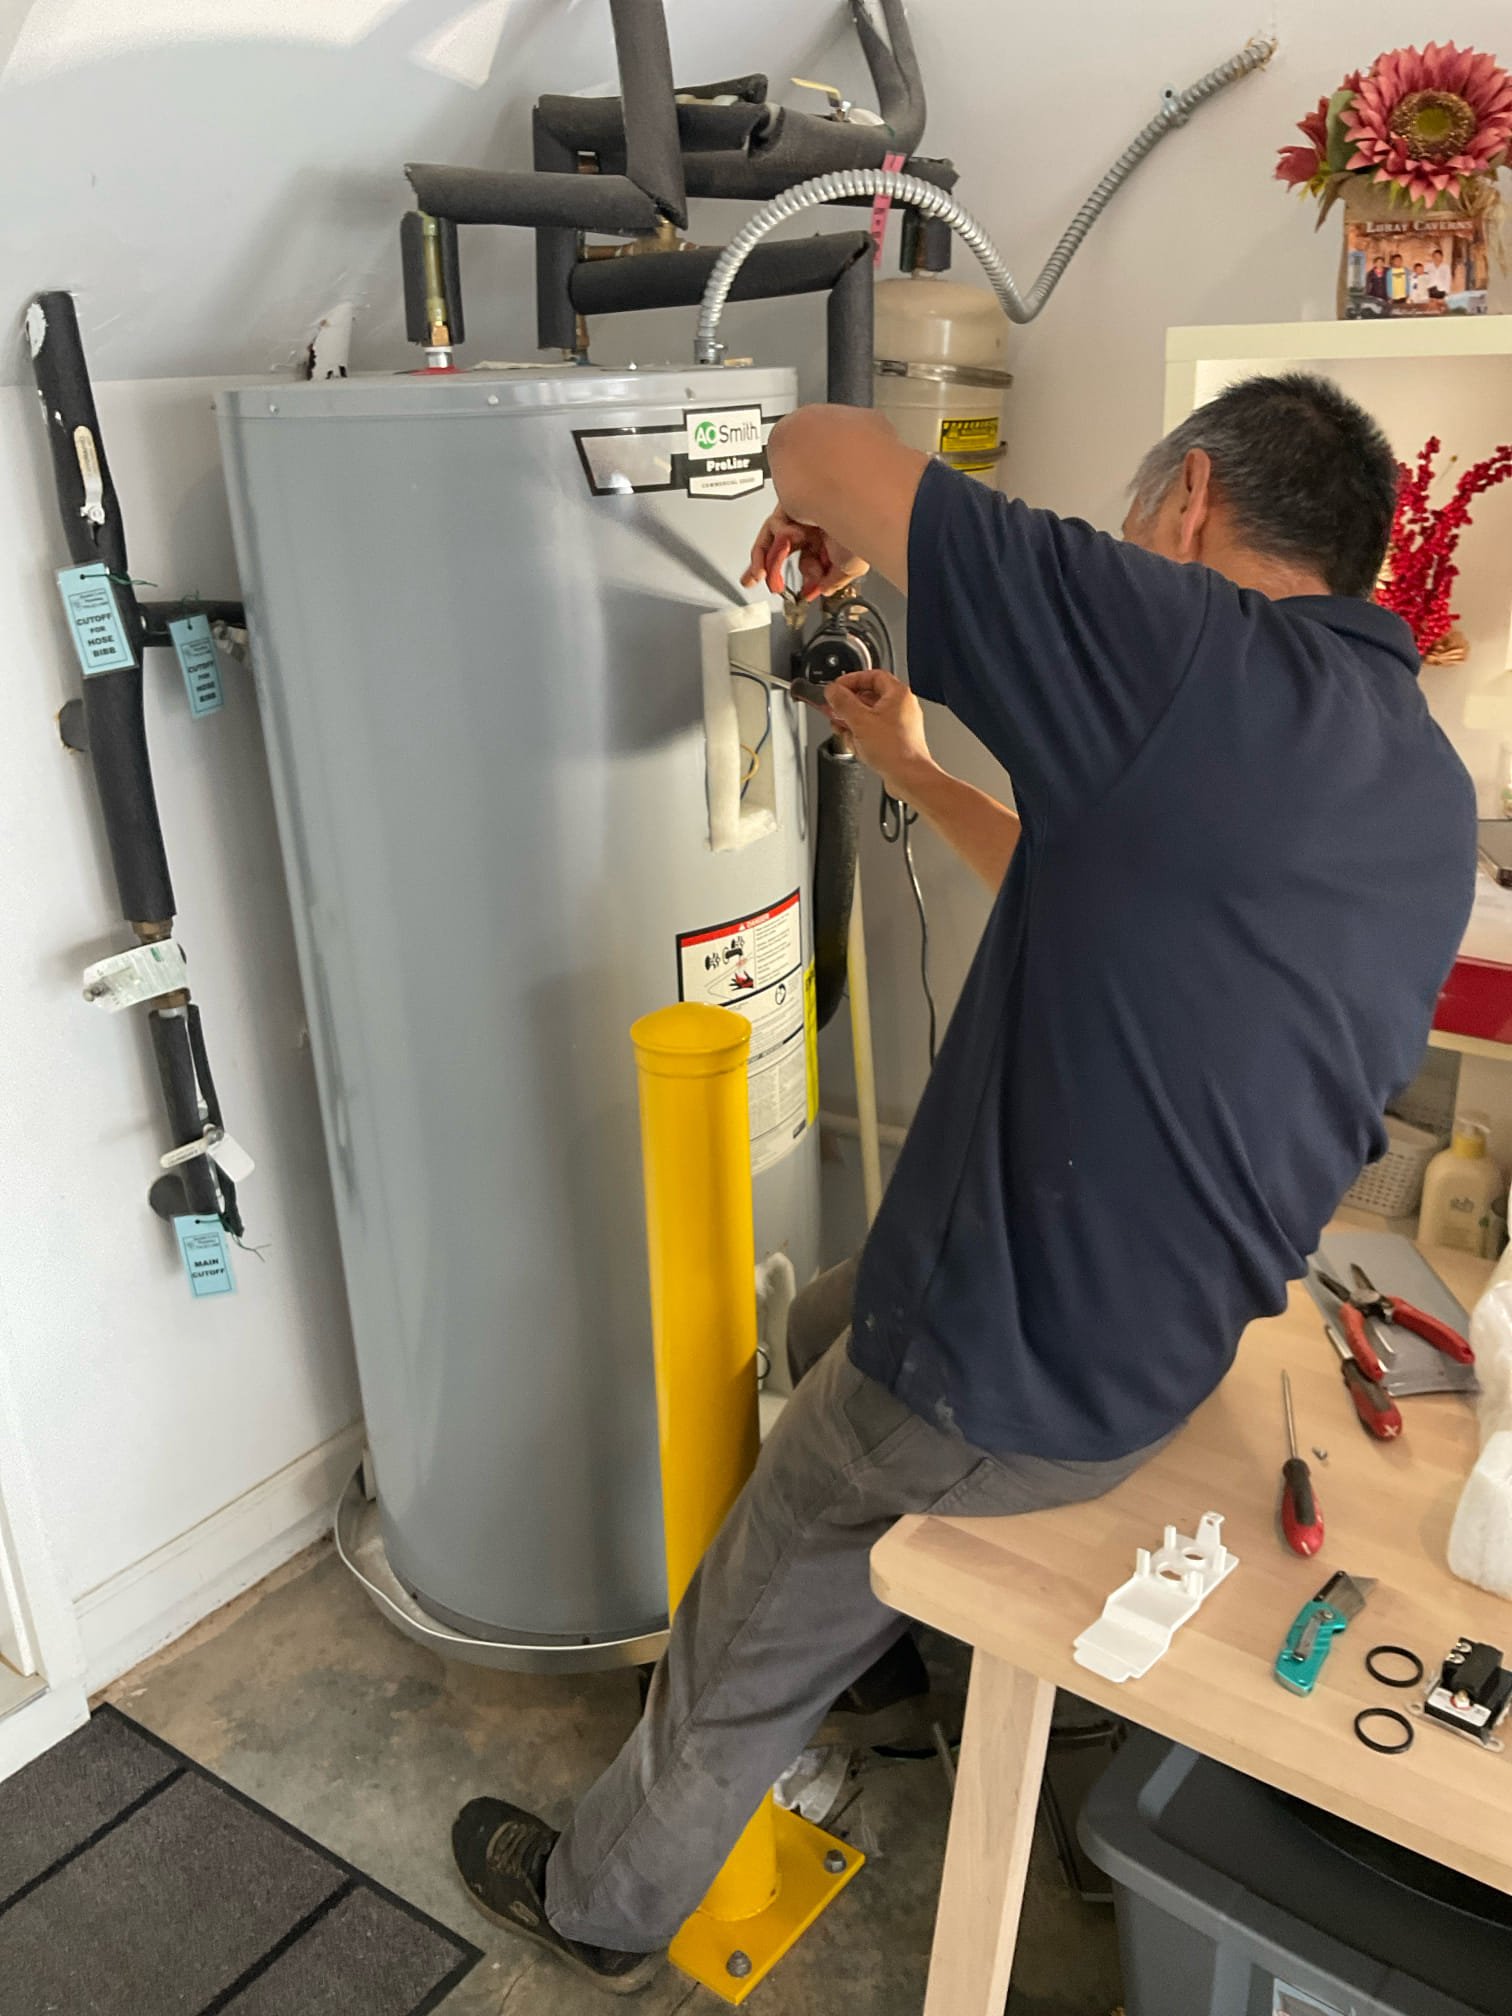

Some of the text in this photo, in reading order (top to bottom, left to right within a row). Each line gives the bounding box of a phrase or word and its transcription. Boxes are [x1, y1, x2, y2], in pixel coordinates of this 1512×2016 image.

[719, 422, 759, 443] Smith
[76, 612, 112, 626] CUTOFF
[191, 1268, 224, 1279] CUTOFF
